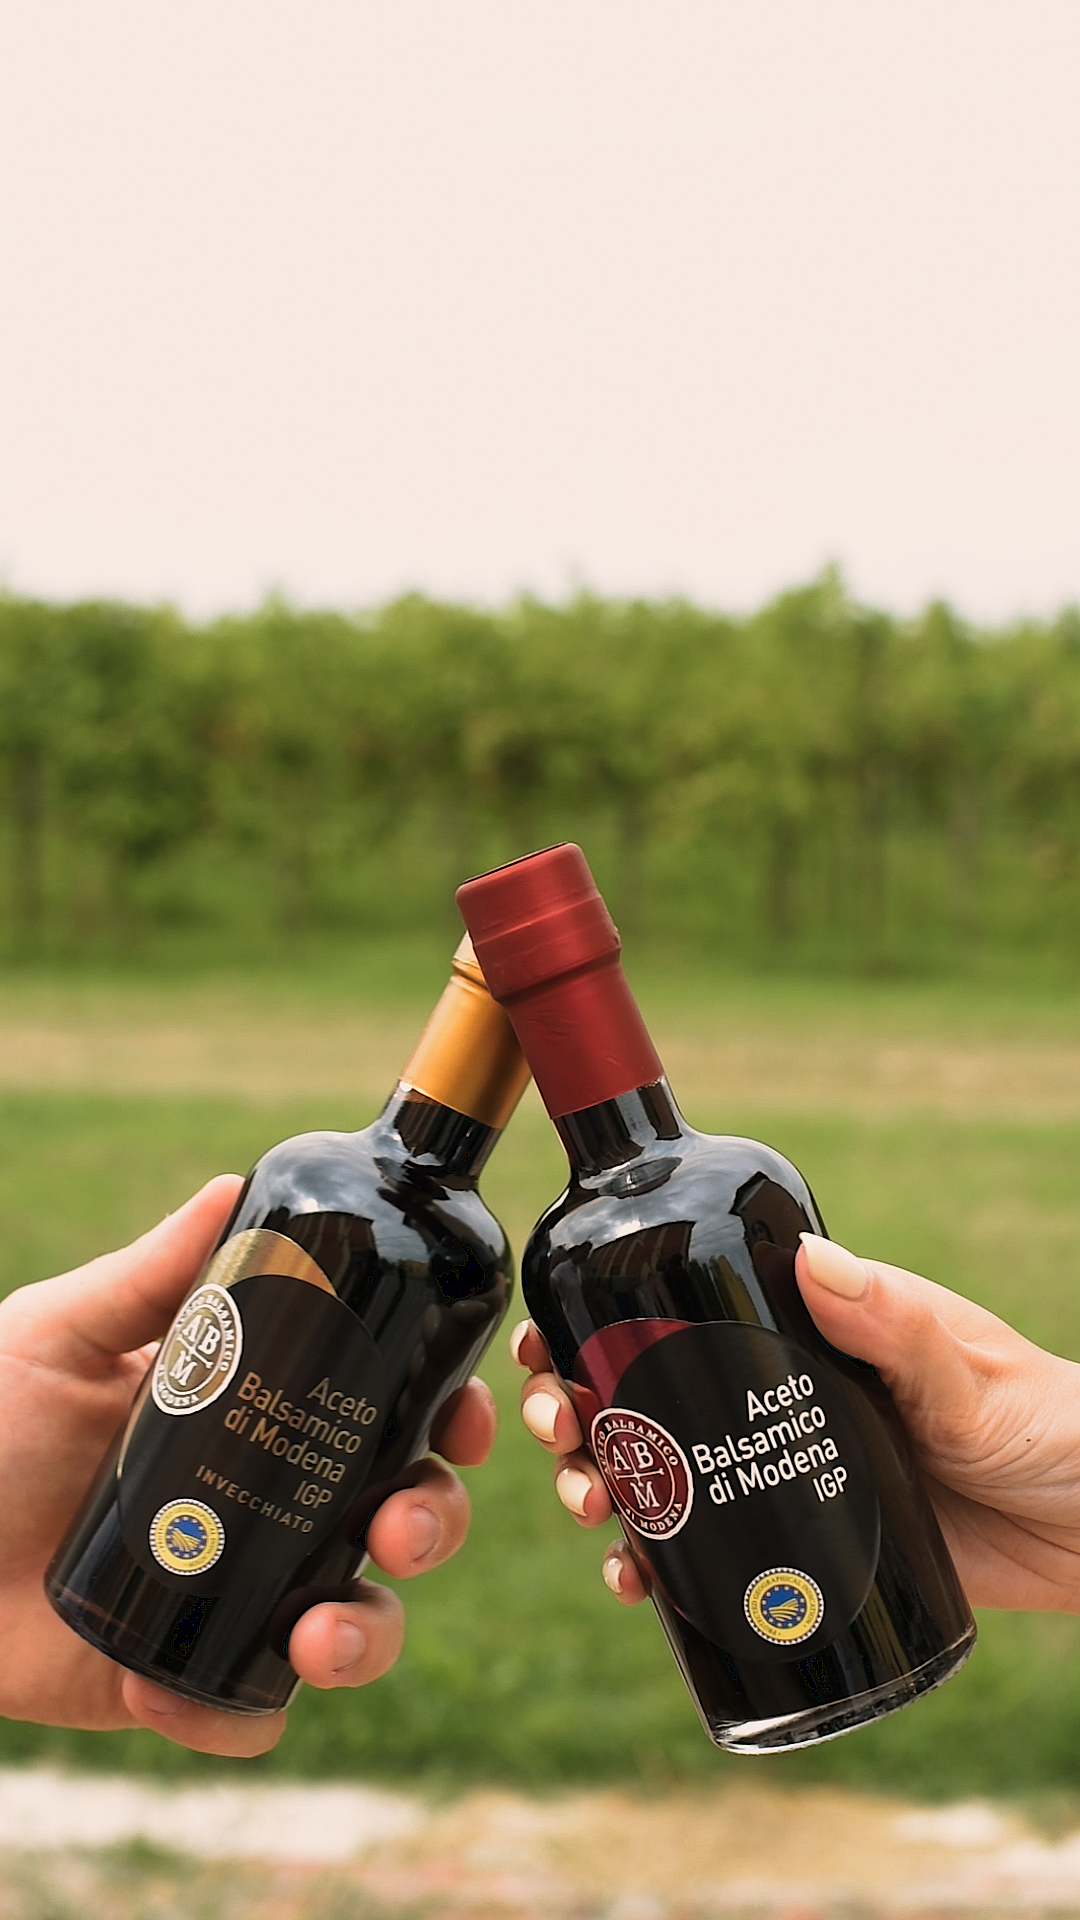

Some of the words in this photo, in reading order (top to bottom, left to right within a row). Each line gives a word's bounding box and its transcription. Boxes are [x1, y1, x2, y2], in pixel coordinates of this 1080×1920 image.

[237, 1371, 362, 1454] Balsamico
[306, 1377, 377, 1425] Aceto
[746, 1374, 814, 1422] Aceto
[224, 1405, 254, 1435] di
[249, 1417, 347, 1484] Modena
[604, 1419, 679, 1466] BALSAMICO
[691, 1406, 826, 1474] Balsamico
[293, 1480, 333, 1509] IGP
[709, 1472, 735, 1505] di
[735, 1437, 839, 1496] Modena
[812, 1466, 848, 1503] IGP
[195, 1465, 314, 1533] INVECCHIATO
[640, 1503, 683, 1532] MODENA
